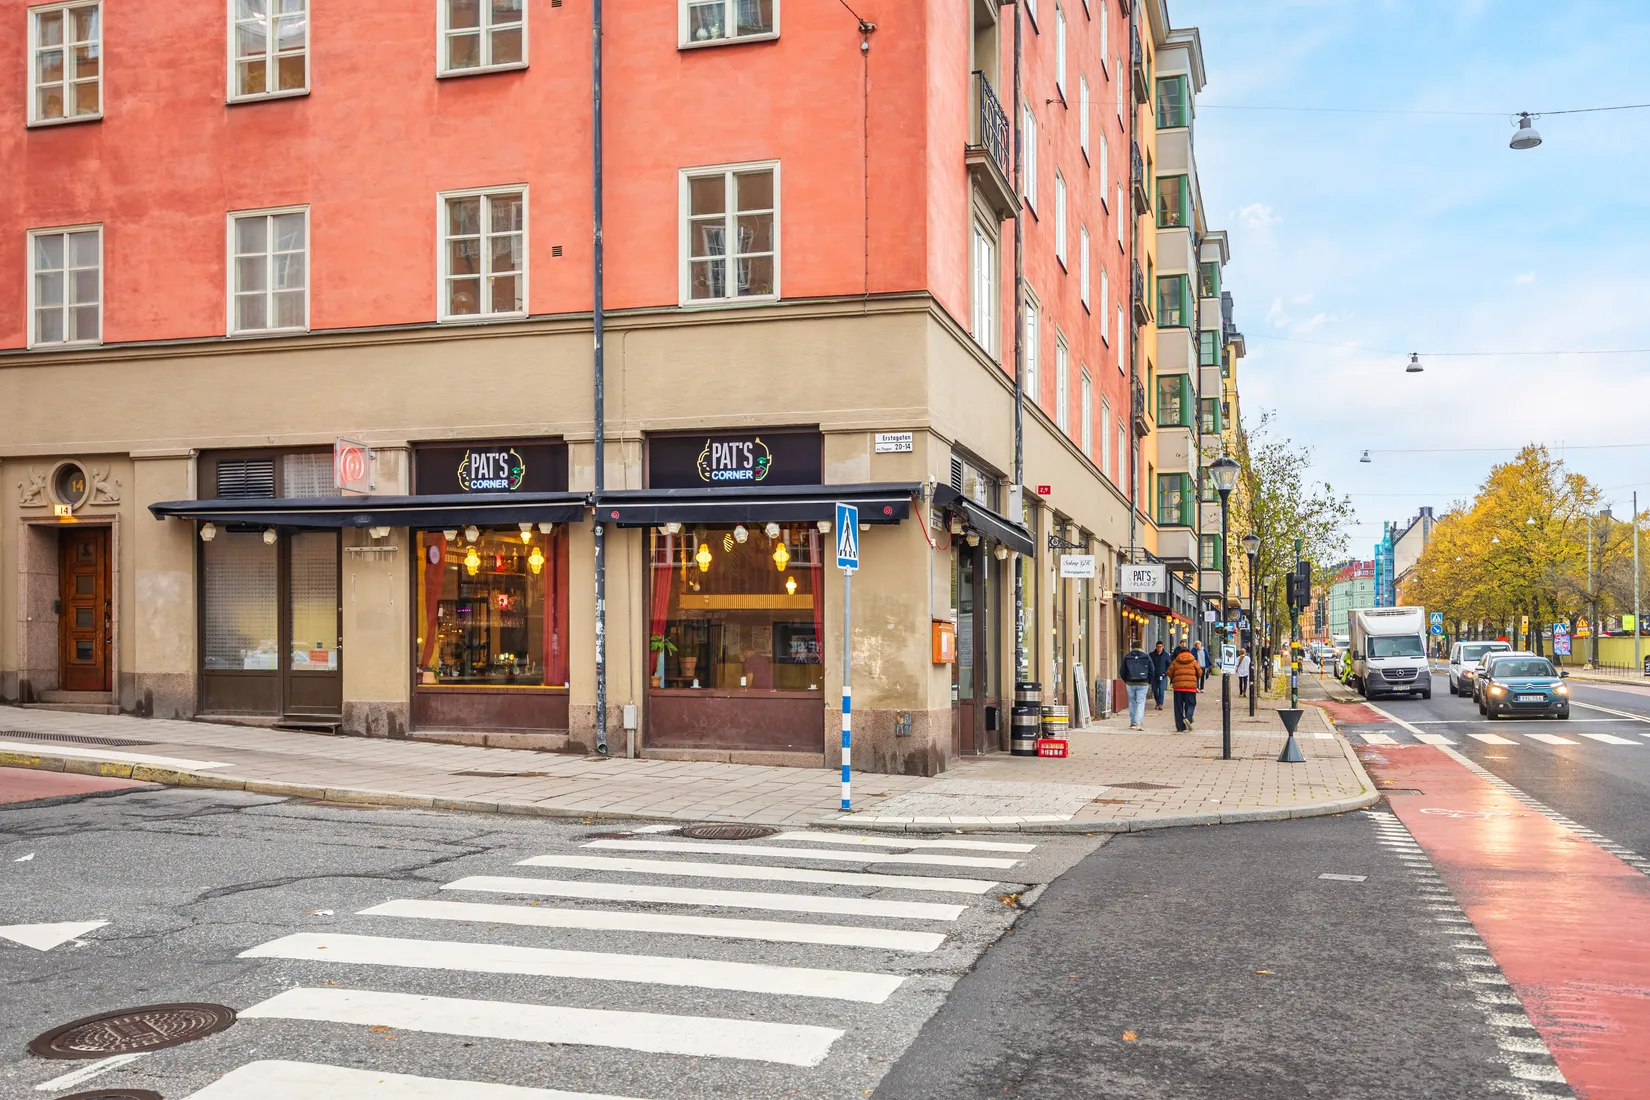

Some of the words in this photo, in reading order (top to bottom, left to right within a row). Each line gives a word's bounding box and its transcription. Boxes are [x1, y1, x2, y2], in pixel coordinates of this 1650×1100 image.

[882, 434, 911, 442] Erstagatan
[712, 442, 753, 469] PAT'S
[471, 452, 508, 478] PAT'S
[711, 470, 753, 480] CORNER
[72, 480, 84, 492] 14
[471, 480, 508, 489] CORNER
[1133, 570, 1152, 581] PAT'S
